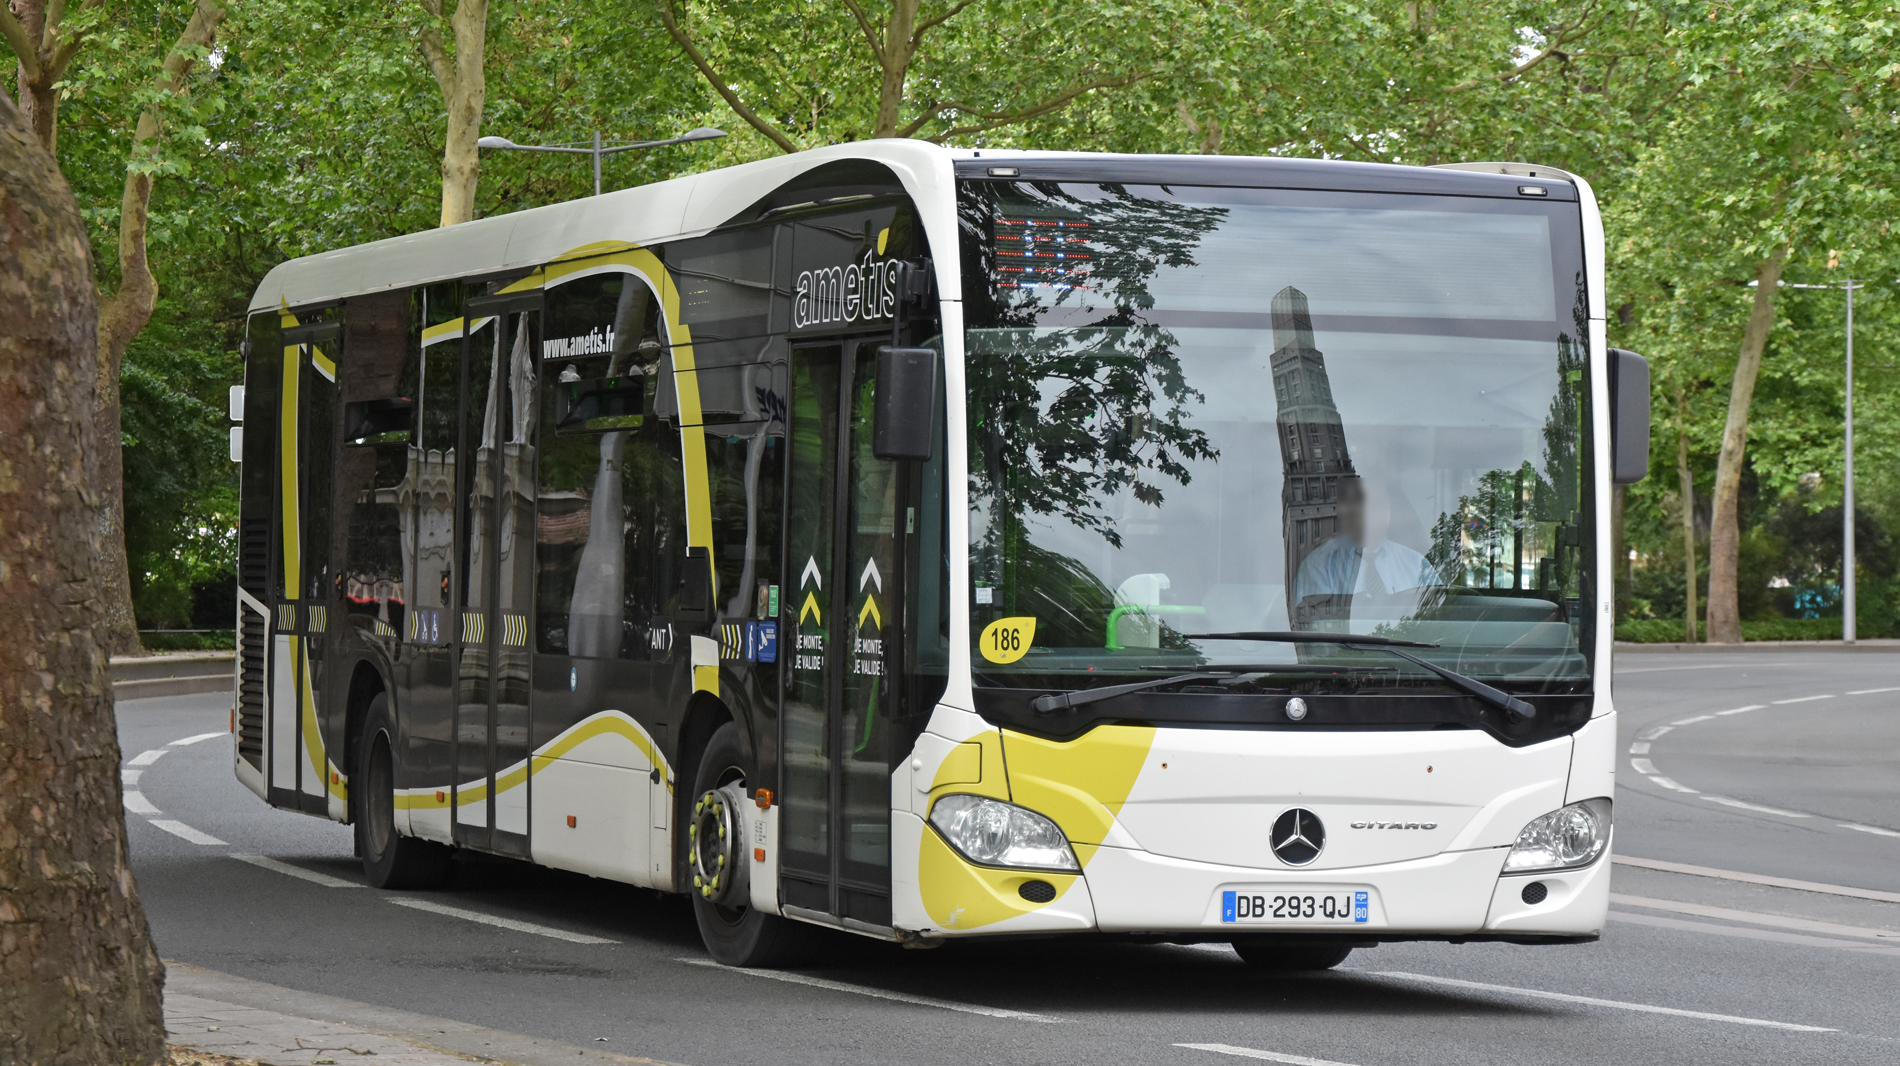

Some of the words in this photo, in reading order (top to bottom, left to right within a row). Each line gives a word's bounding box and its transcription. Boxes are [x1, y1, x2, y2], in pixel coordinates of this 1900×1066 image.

[795, 228, 897, 328] ametis
[543, 324, 615, 359] www.ametis.fr
[649, 628, 666, 650] ANT
[803, 635, 823, 652] MONTE,
[862, 639, 883, 656] MONTE,
[991, 628, 1020, 651] 186
[795, 655, 801, 669] JE
[802, 655, 820, 670] VALIDE
[853, 659, 860, 674] JE
[861, 660, 880, 675] VALIDE
[1350, 821, 1437, 830] CITARO
[1226, 909, 1232, 917] F
[1237, 895, 1351, 919] DB-293-QJ
[1356, 908, 1367, 918] 80
